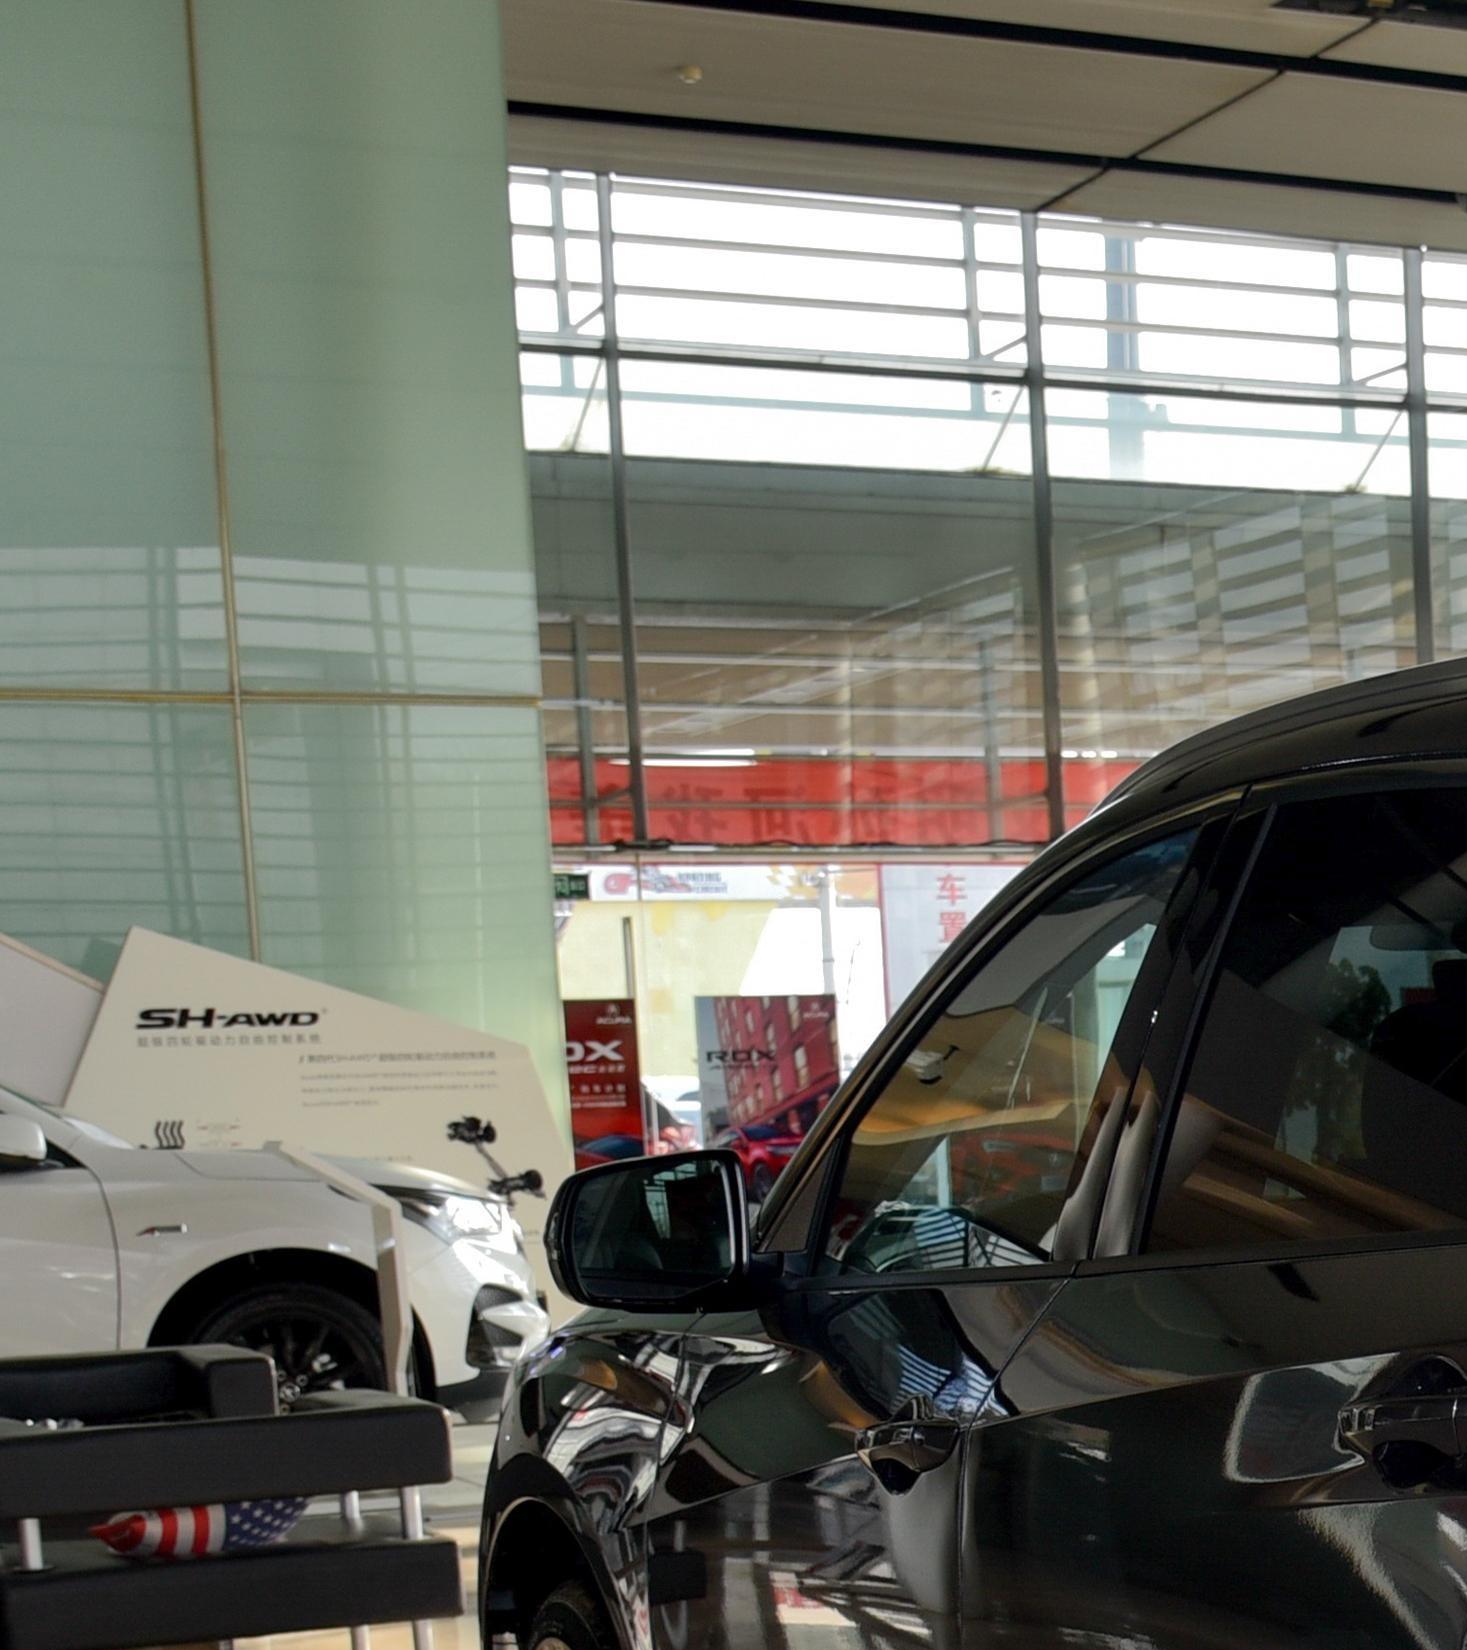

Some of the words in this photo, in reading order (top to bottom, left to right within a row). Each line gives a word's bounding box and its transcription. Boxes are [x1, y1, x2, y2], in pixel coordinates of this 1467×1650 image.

[135, 1007, 320, 1030] SH-AWD
[566, 1039, 625, 1063] DX
[706, 1049, 777, 1063] RDX
